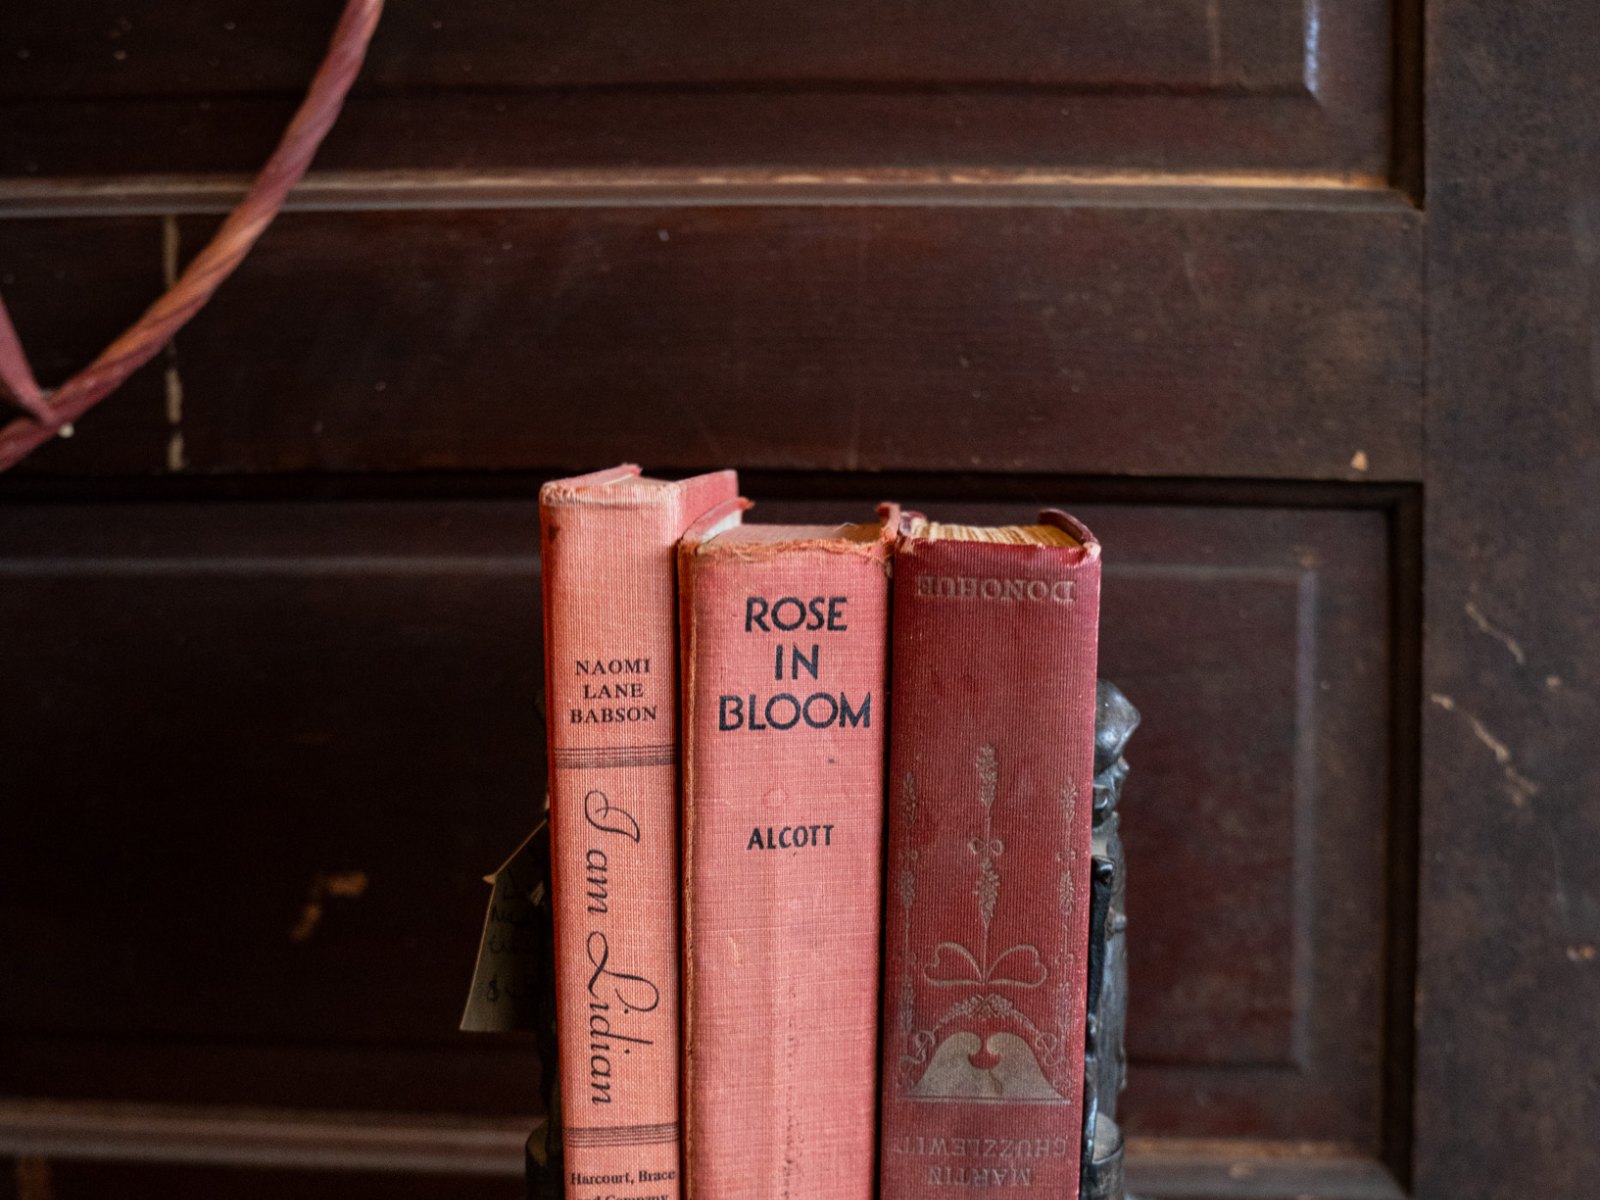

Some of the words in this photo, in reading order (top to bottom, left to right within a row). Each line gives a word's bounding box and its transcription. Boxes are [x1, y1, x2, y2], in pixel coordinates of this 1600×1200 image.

[916, 575, 1077, 602] DONOHUE
[745, 597, 847, 632] ROSE
[575, 658, 650, 675] NAOMI
[775, 644, 819, 680] IN
[584, 683, 644, 699] LANE
[570, 705, 658, 724] BABSON
[719, 692, 871, 731] BLOOM
[747, 825, 834, 850] ALCOTT
[586, 849, 608, 913] am
[587, 931, 659, 1104] Lidian
[571, 1172, 635, 1185] Harcourt,
[639, 1170, 676, 1182] Brace
[927, 1167, 1032, 1186] MARTIN
